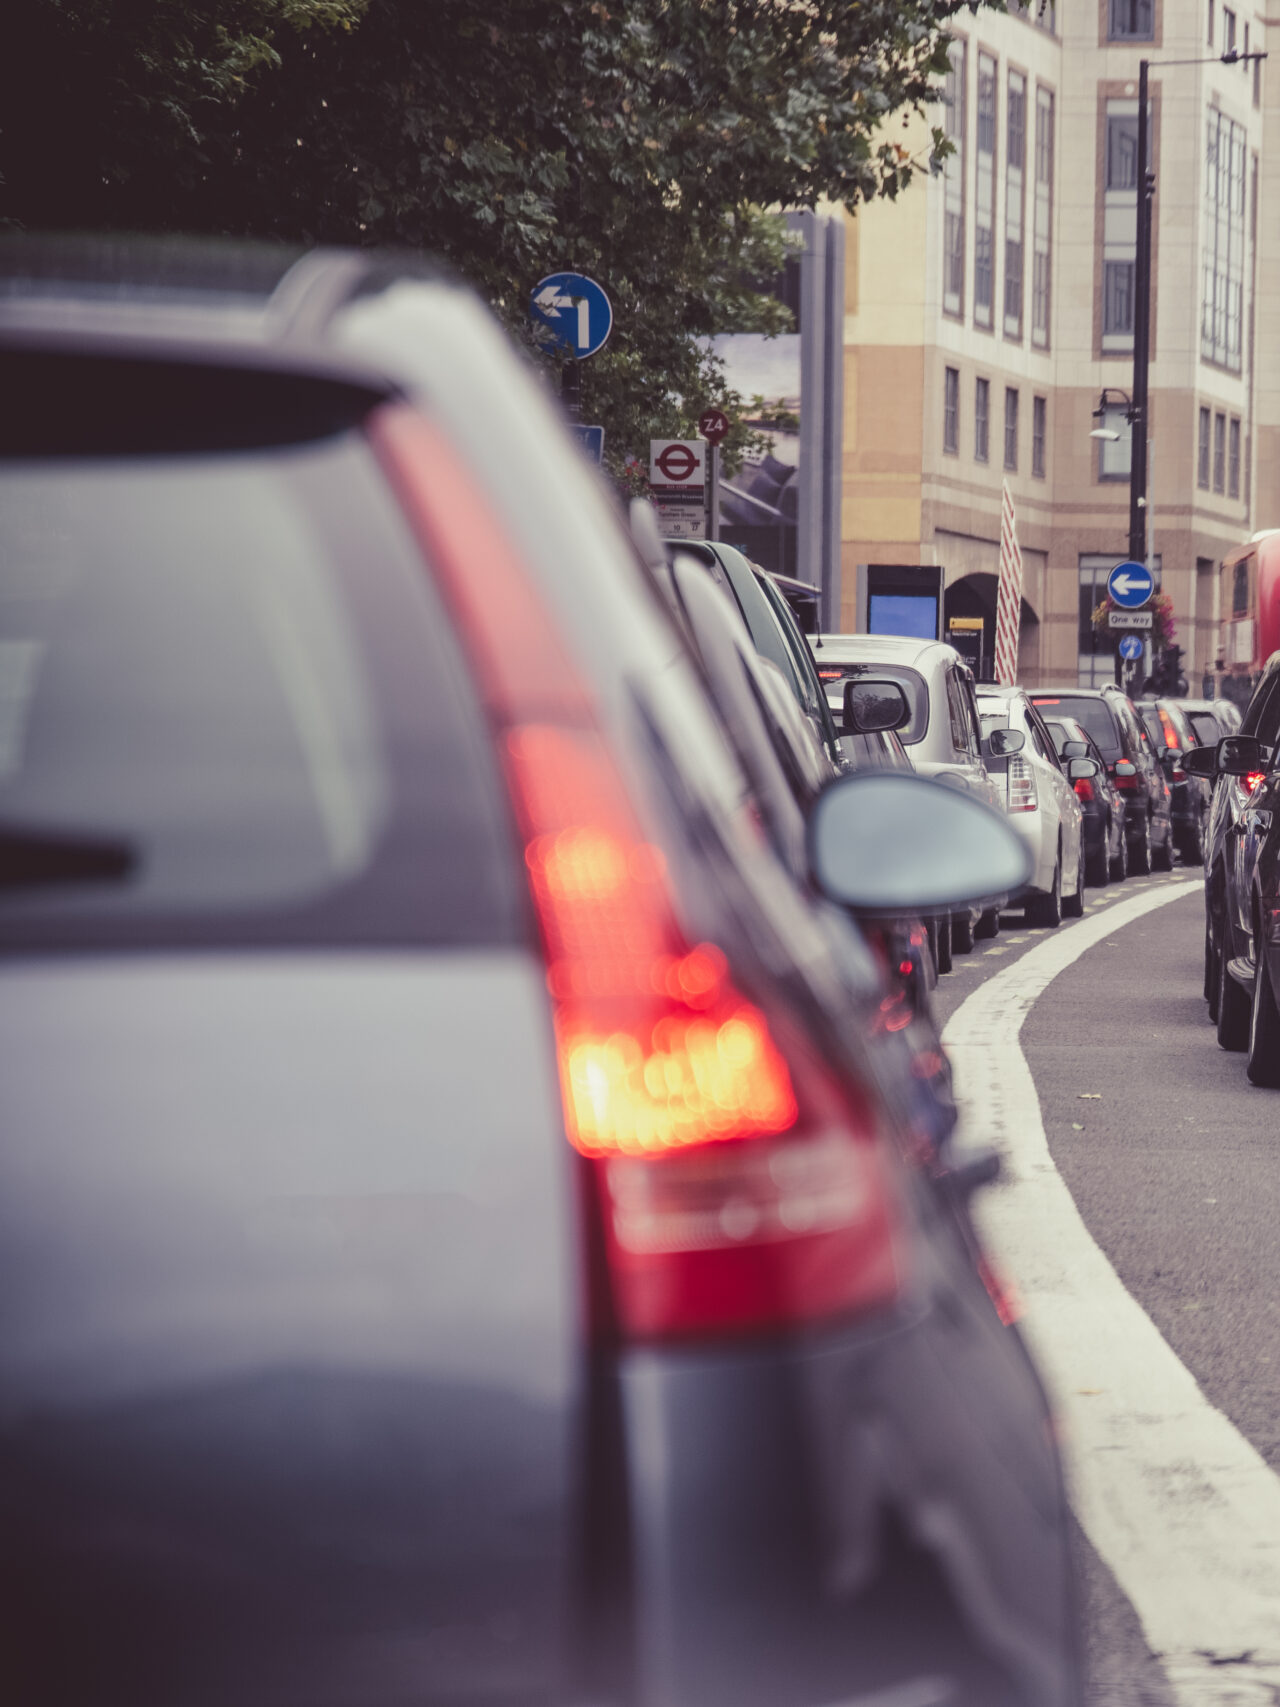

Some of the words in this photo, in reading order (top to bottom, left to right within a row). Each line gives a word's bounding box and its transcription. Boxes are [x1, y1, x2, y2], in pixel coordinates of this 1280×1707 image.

[704, 418, 724, 432] Z4
[1111, 615, 1128, 624] One
[1132, 617, 1150, 626] way
